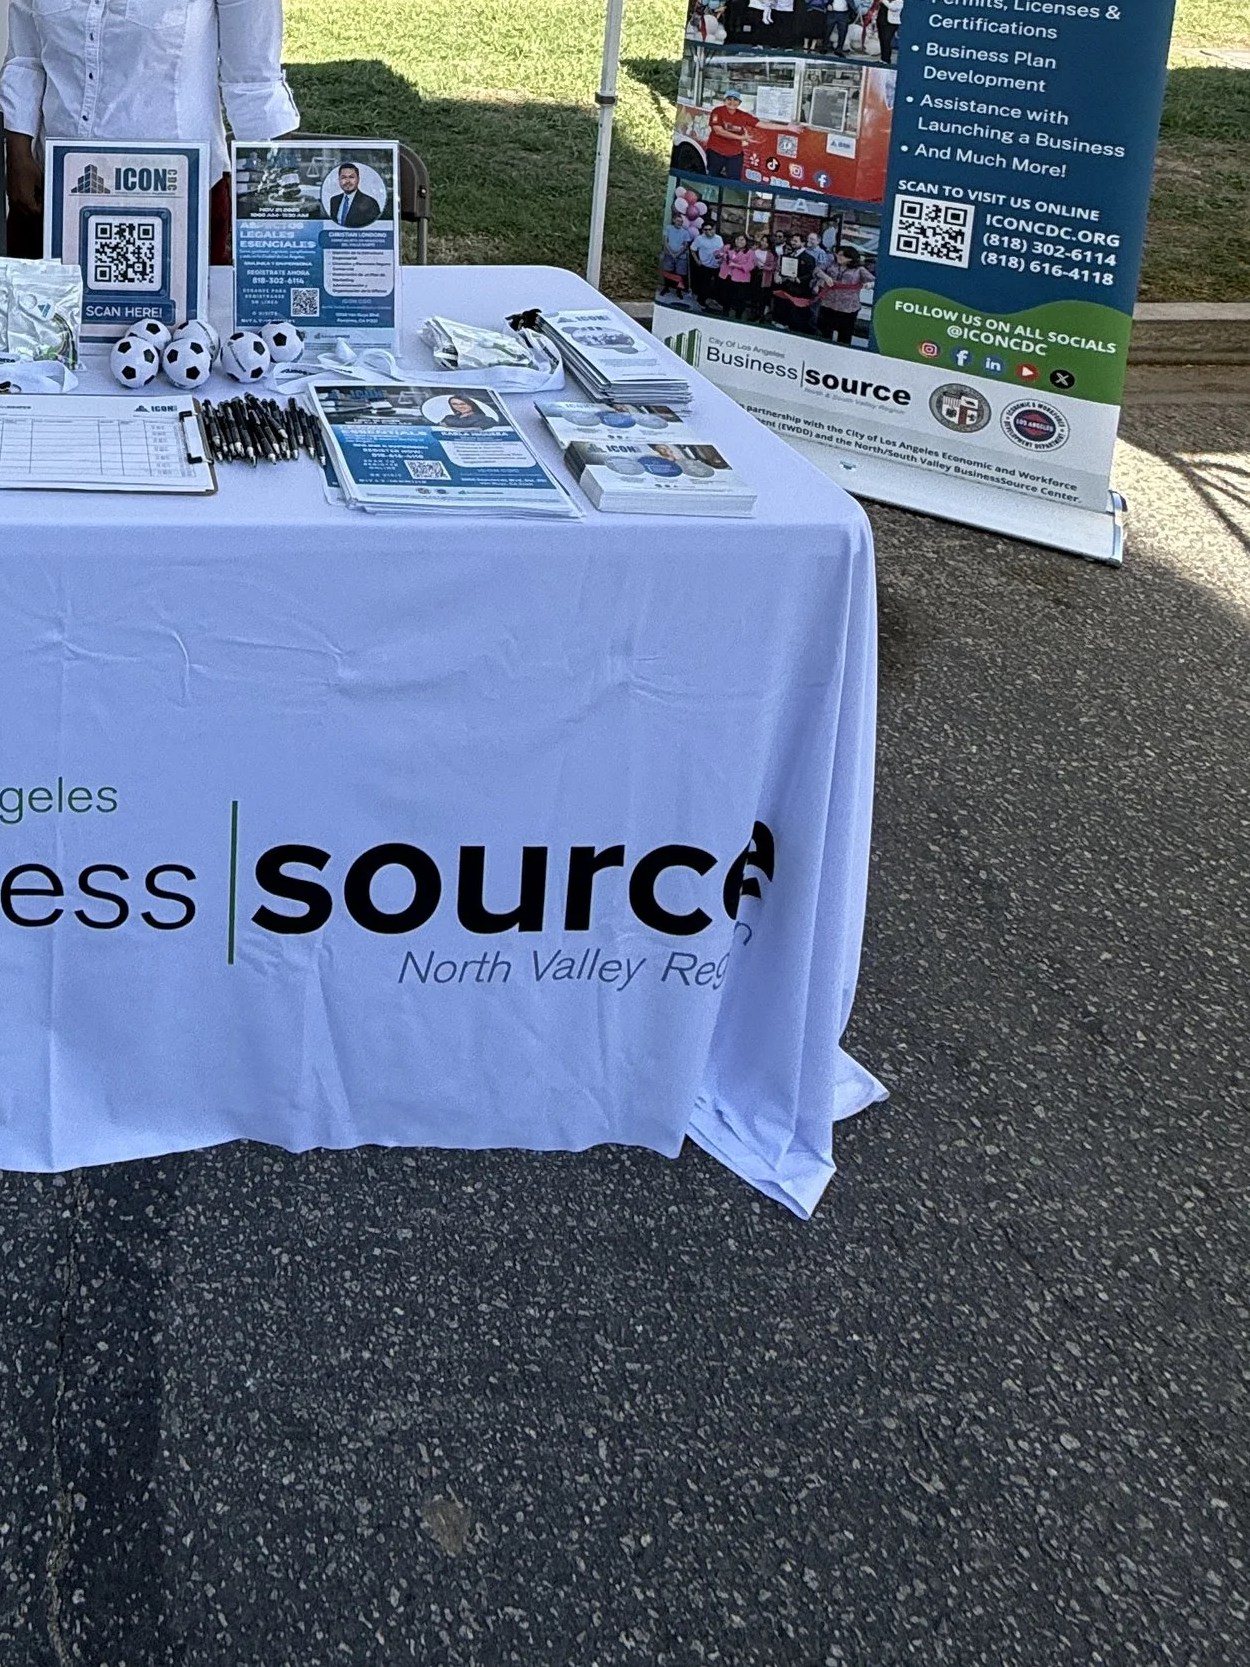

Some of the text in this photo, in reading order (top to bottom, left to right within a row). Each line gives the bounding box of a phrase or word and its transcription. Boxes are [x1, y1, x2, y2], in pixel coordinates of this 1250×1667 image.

[929, 15, 1058, 39] Certifications
[1106, 5, 1121, 21] &
[926, 43, 1056, 69] Business Plan
[924, 66, 1046, 93] Development
[920, 95, 1069, 125] Assistance with
[918, 118, 1125, 158] Launching a Business
[915, 143, 1067, 178] And Much More!
[115, 168, 177, 191] ICON CDC
[898, 180, 1100, 222] SCAN TO VISIT US ONLINE
[986, 213, 1120, 248] ICONCDC.ORG
[983, 233, 1117, 267] (818) 302-6114
[981, 251, 1114, 286] (818) 616-4118
[86, 306, 162, 318] SCAN HERE!
[895, 300, 1117, 355] FOLLOW US ON ALL SOCIALS
[947, 324, 1048, 357] @ICONCDC
[706, 346, 798, 380] Business
[805, 368, 911, 406] source
[397, 947, 648, 992] North Valley
